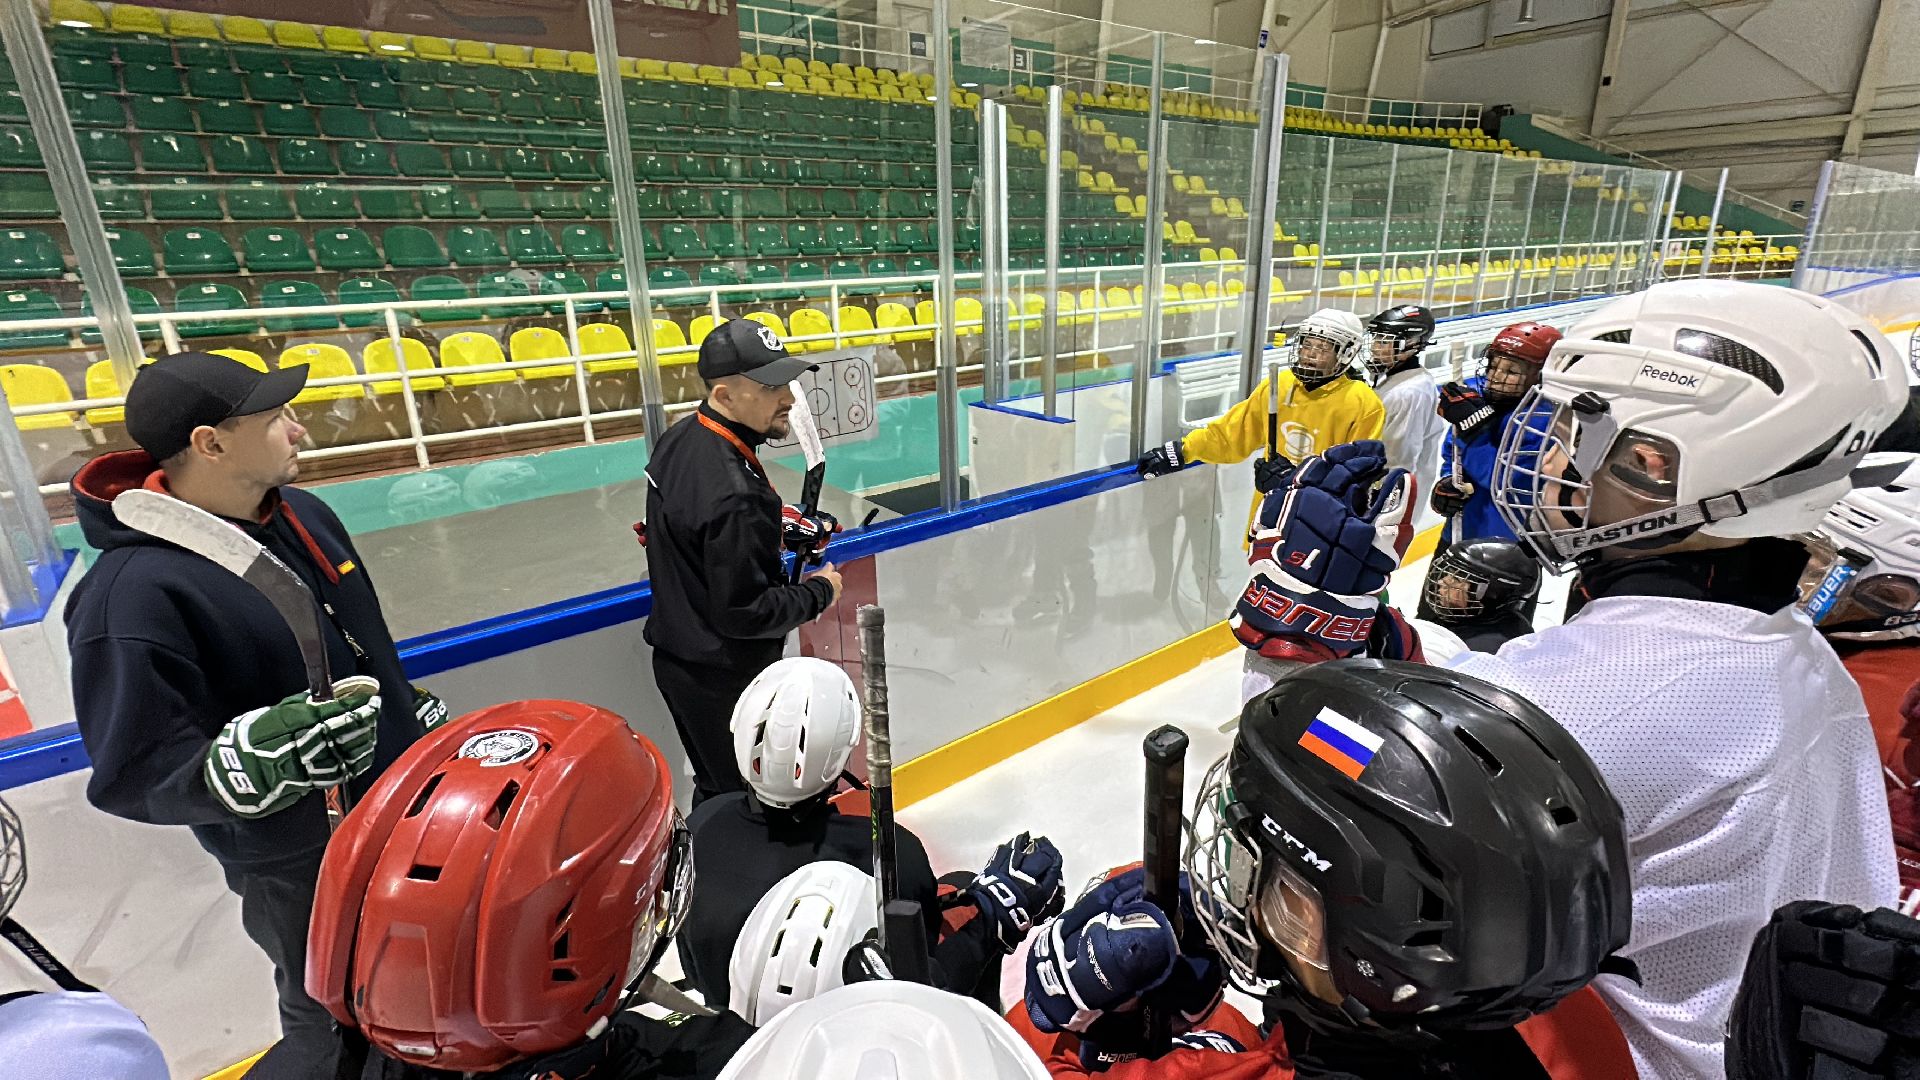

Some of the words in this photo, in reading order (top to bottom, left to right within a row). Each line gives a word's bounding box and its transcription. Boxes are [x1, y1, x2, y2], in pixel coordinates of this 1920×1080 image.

[1641, 364, 1699, 387] Reebok
[1573, 512, 1677, 548] EASTON
[1244, 578, 1376, 642] BAUER
